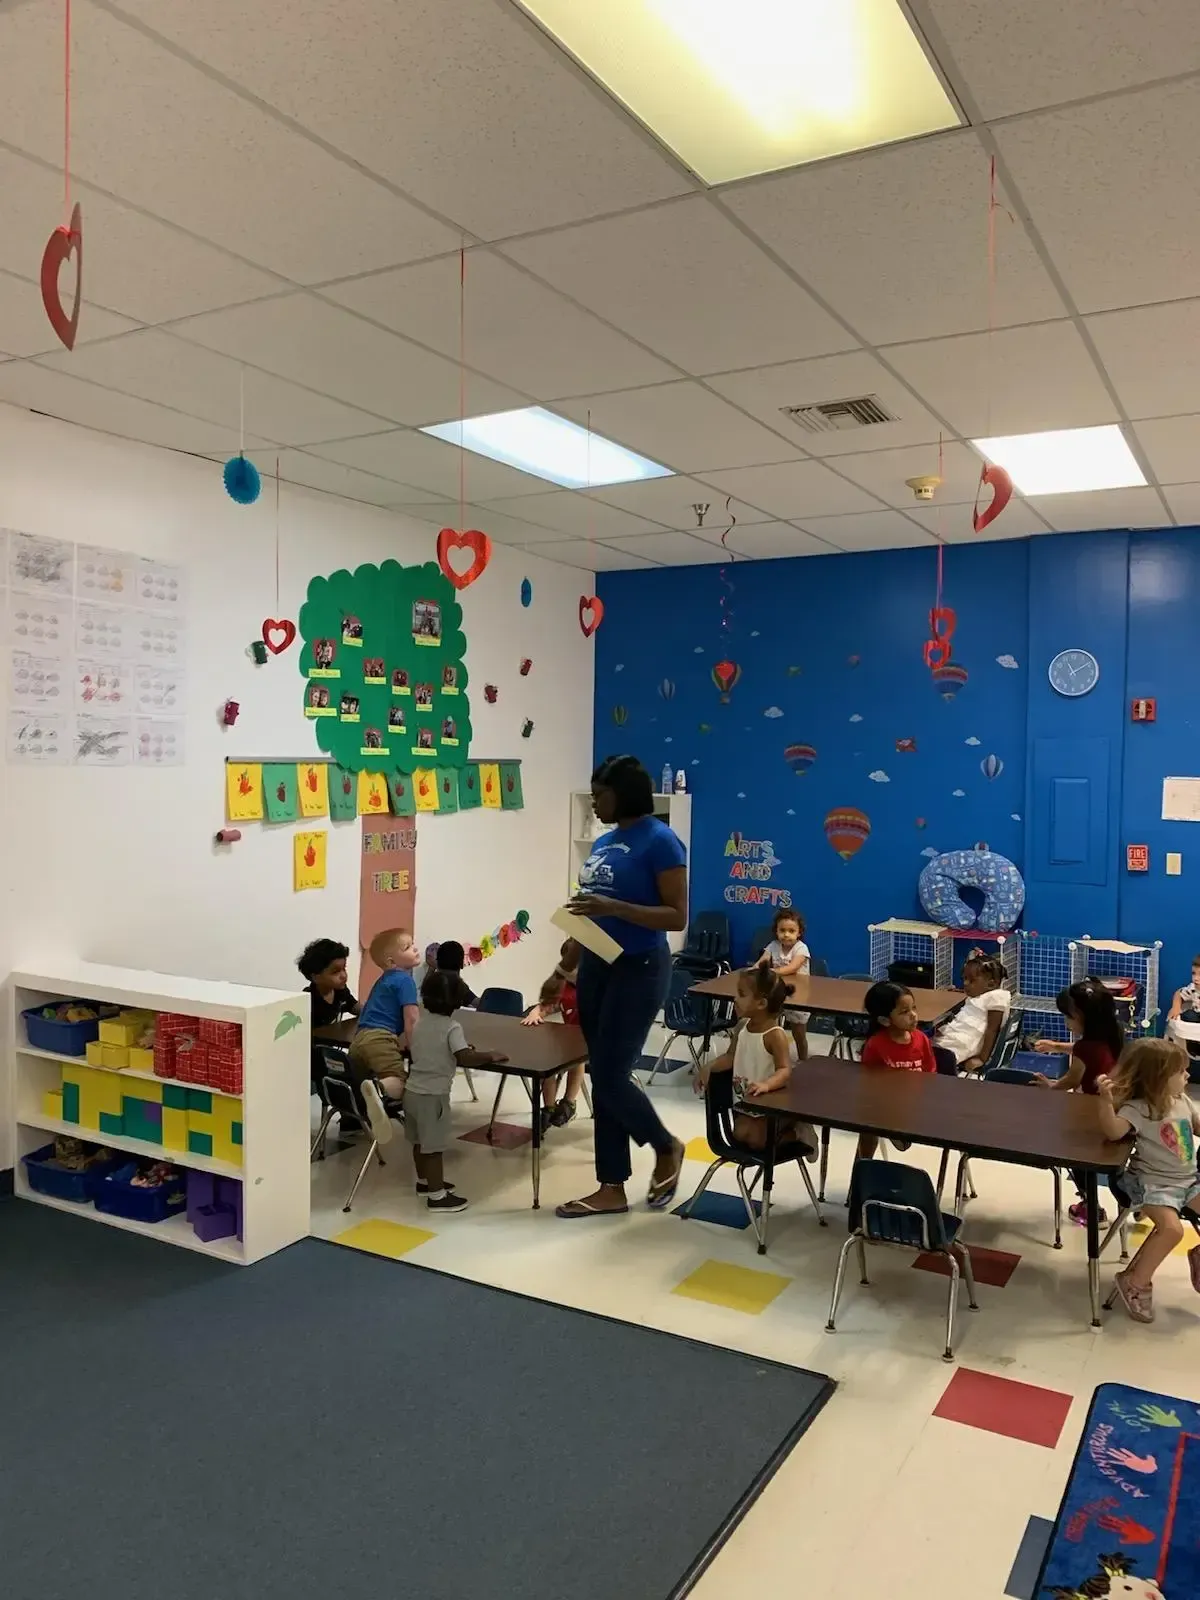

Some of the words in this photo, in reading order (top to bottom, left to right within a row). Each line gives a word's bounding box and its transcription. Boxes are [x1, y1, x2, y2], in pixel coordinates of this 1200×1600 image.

[363, 828, 417, 853] FAMILY
[724, 839, 774, 859] ARTS
[1129, 848, 1146, 859] FIRE
[372, 870, 409, 892] TREE
[730, 861, 772, 881] AND
[724, 885, 792, 909] CRAFTS
[1106, 1400, 1150, 1433] LOYAL
